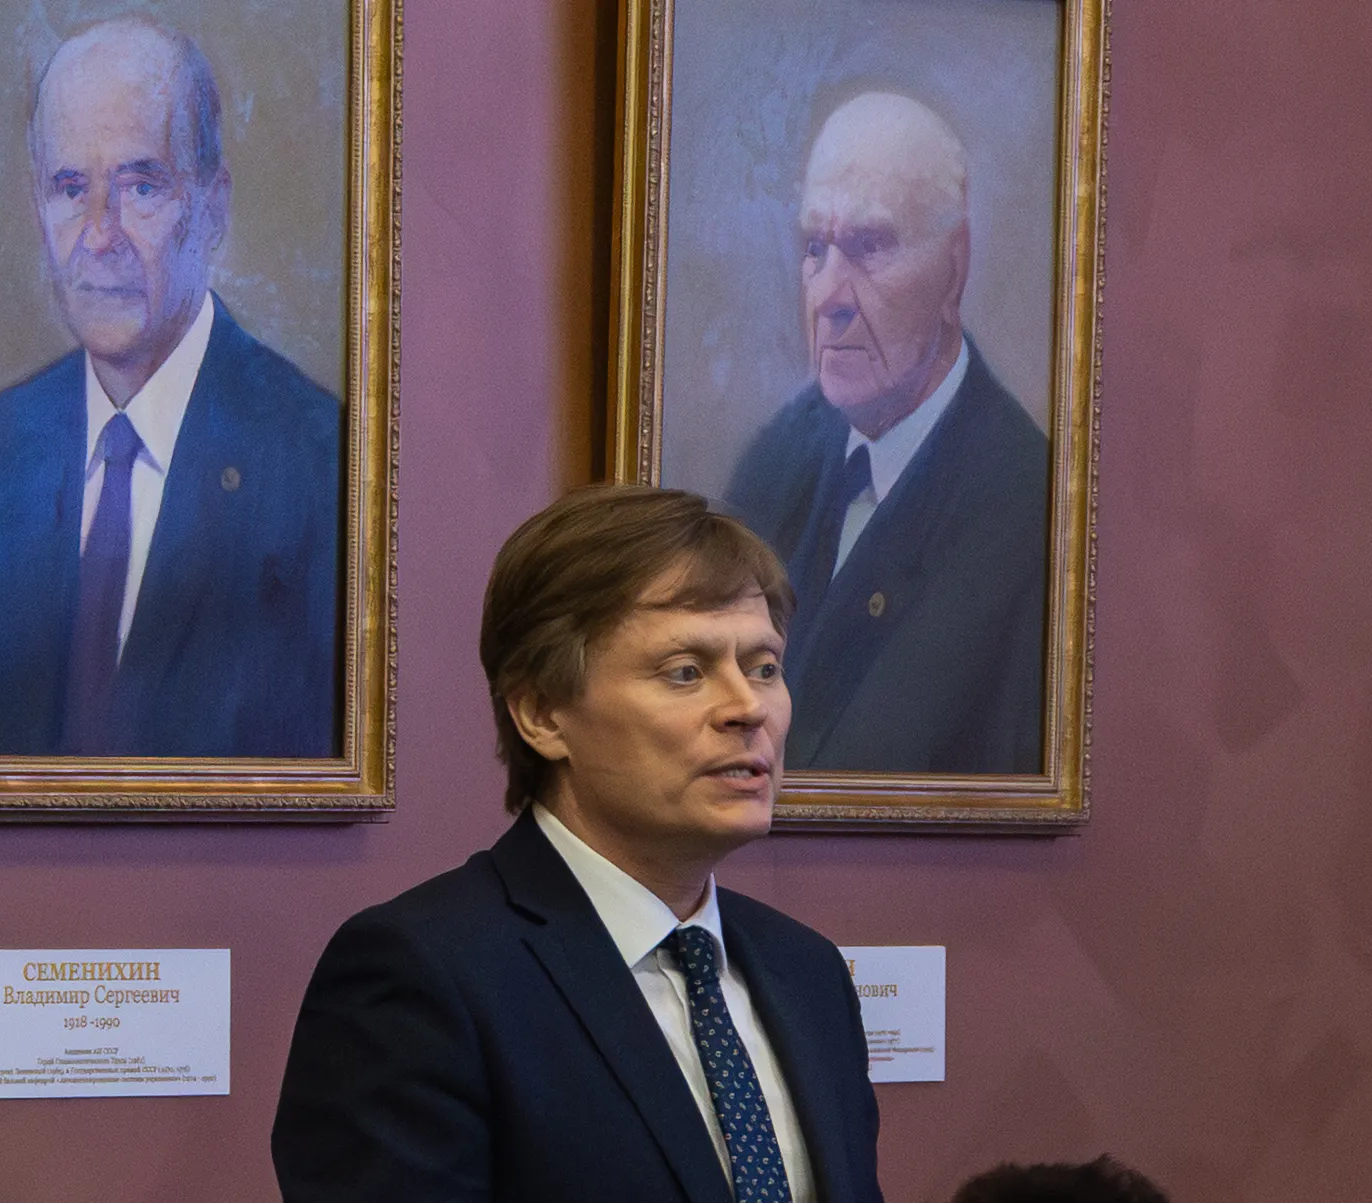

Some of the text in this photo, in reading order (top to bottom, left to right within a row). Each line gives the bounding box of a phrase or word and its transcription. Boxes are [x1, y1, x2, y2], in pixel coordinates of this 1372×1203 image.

[22, 962, 161, 981] СЕМЕНИХИН
[3, 984, 180, 1009] Владимир Сергеевич
[63, 1015, 88, 1030] 1918
